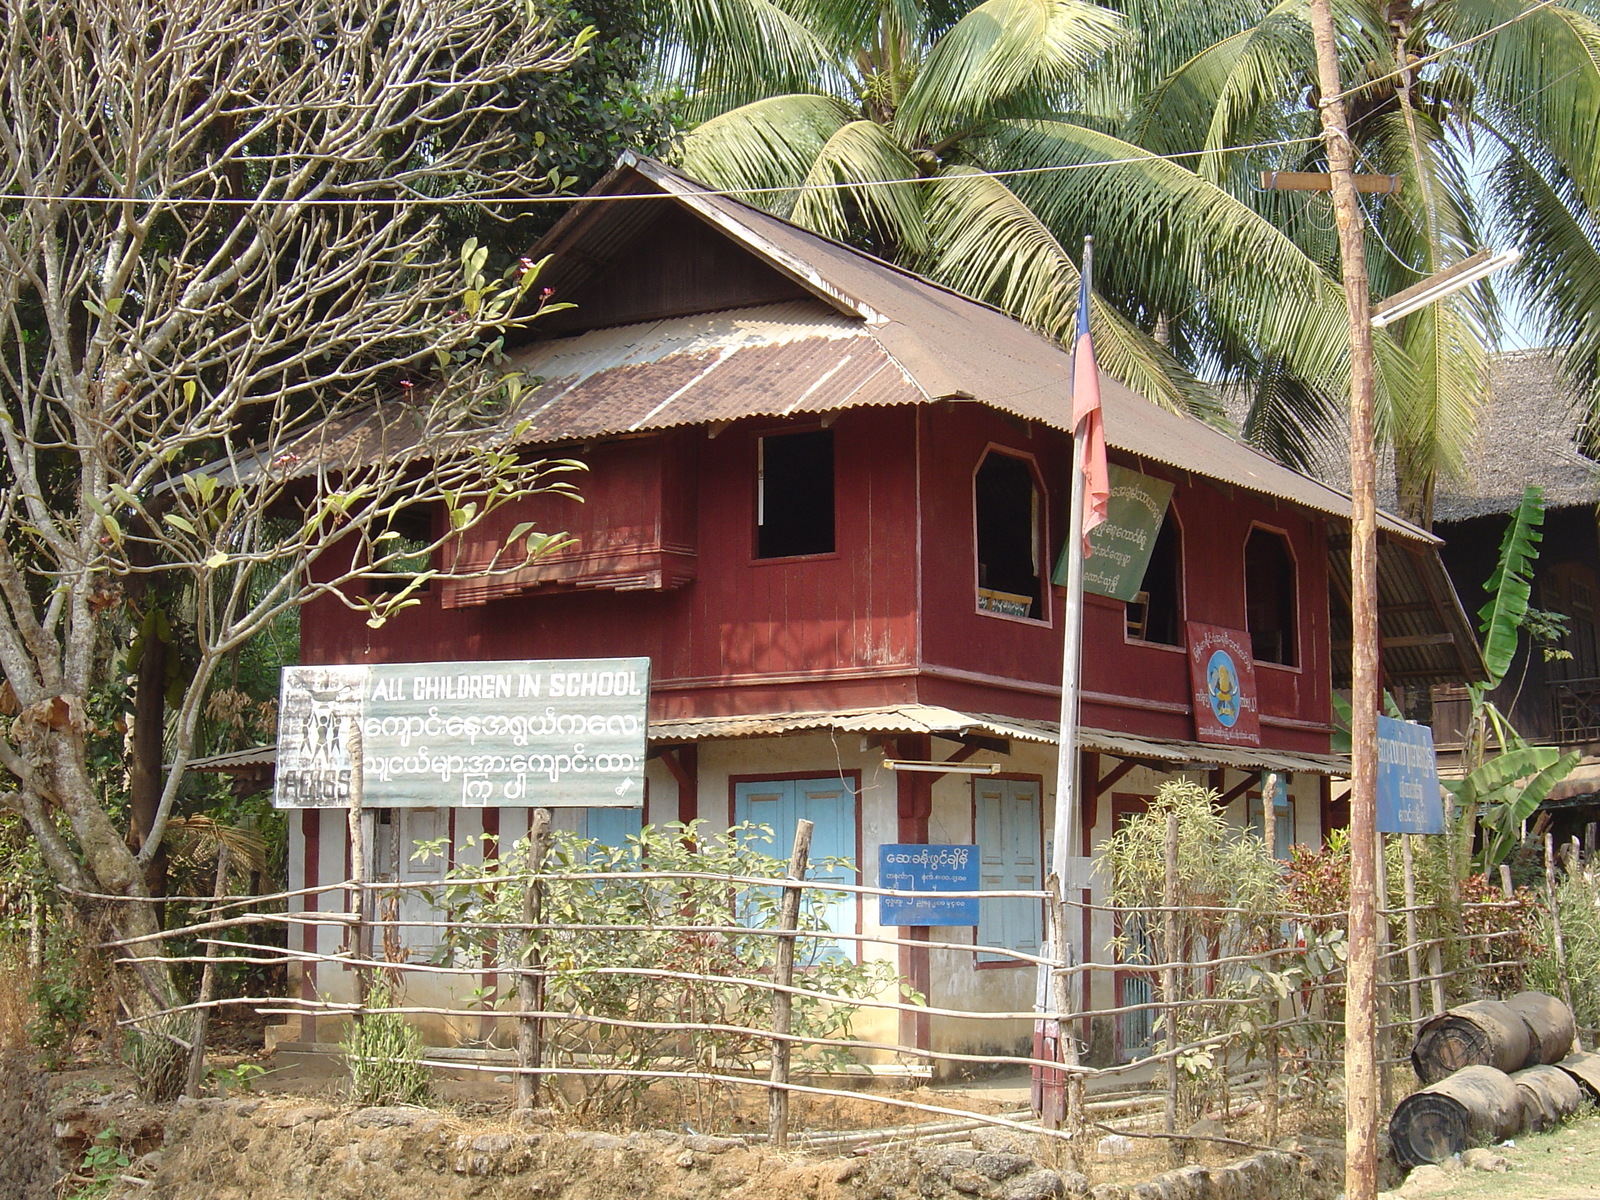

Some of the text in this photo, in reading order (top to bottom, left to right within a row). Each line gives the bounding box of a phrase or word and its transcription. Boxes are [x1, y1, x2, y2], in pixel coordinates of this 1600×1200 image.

[371, 671, 641, 701] ALL CHILDREN IN SCHOOL
